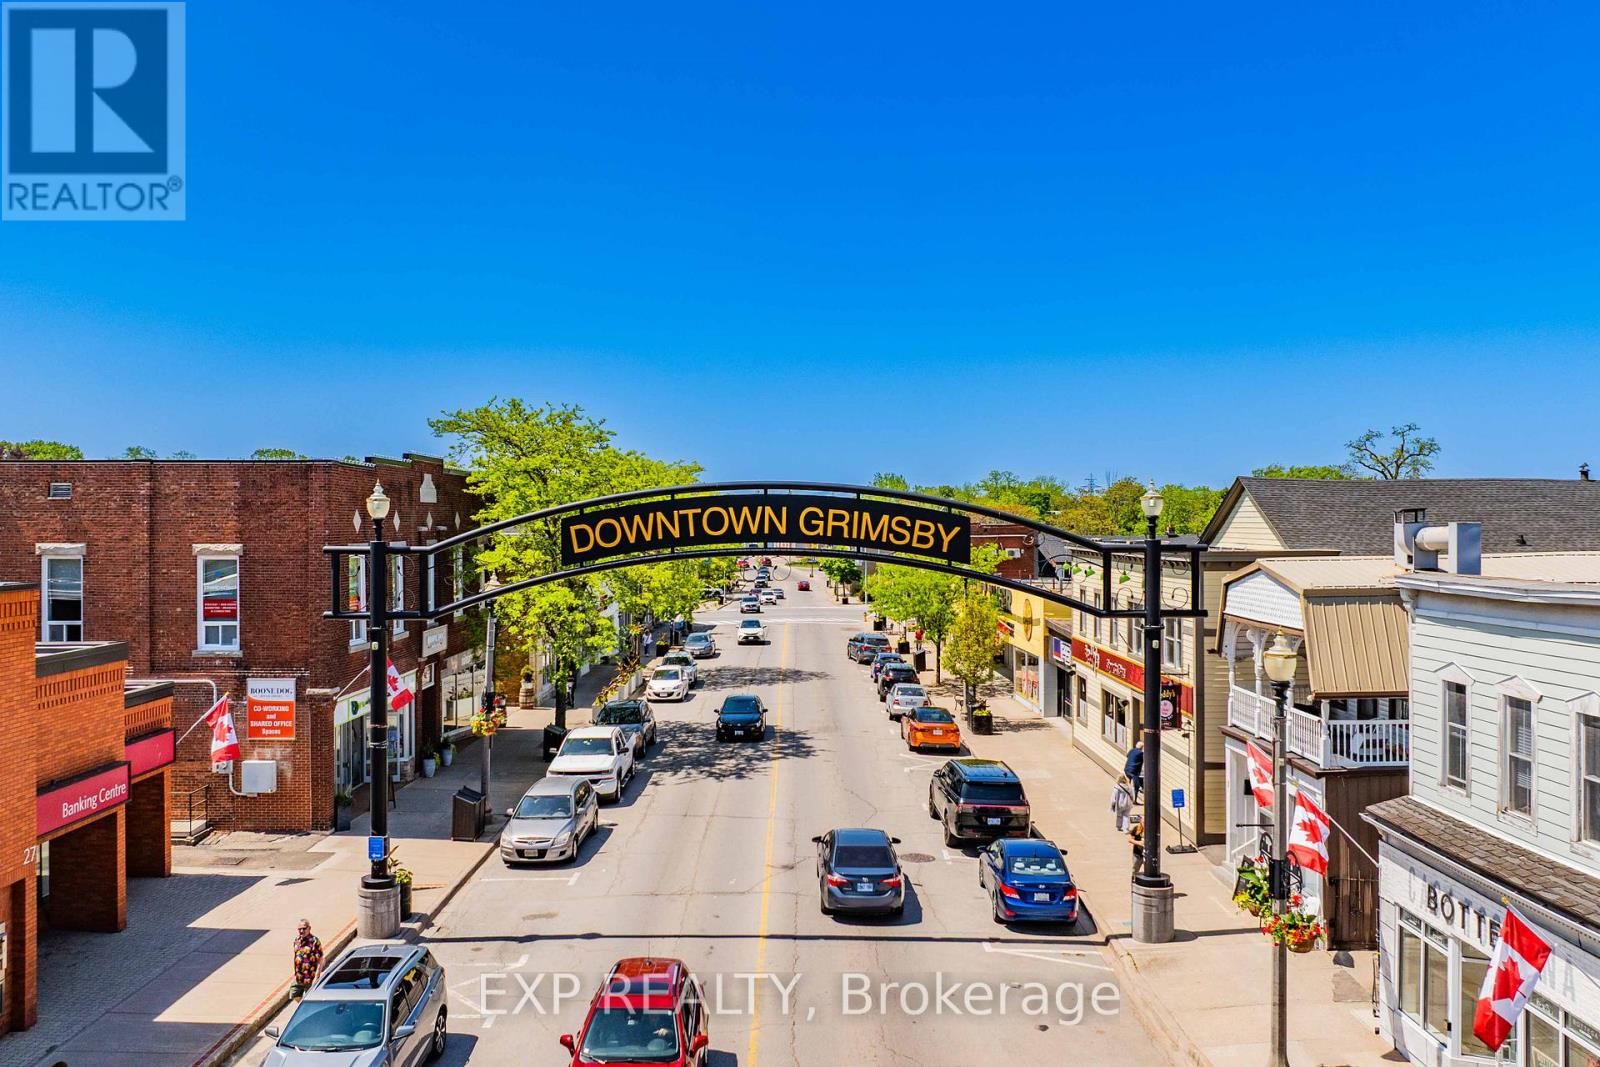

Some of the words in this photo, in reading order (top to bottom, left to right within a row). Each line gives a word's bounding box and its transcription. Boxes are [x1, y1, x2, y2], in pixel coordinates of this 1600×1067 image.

[569, 506, 787, 554] DOWNTOWN
[799, 506, 961, 553] GRIMSBY
[261, 728, 281, 736] Spaces
[62, 794, 98, 818] Banking
[99, 783, 127, 803] Centre
[23, 845, 37, 865] 27
